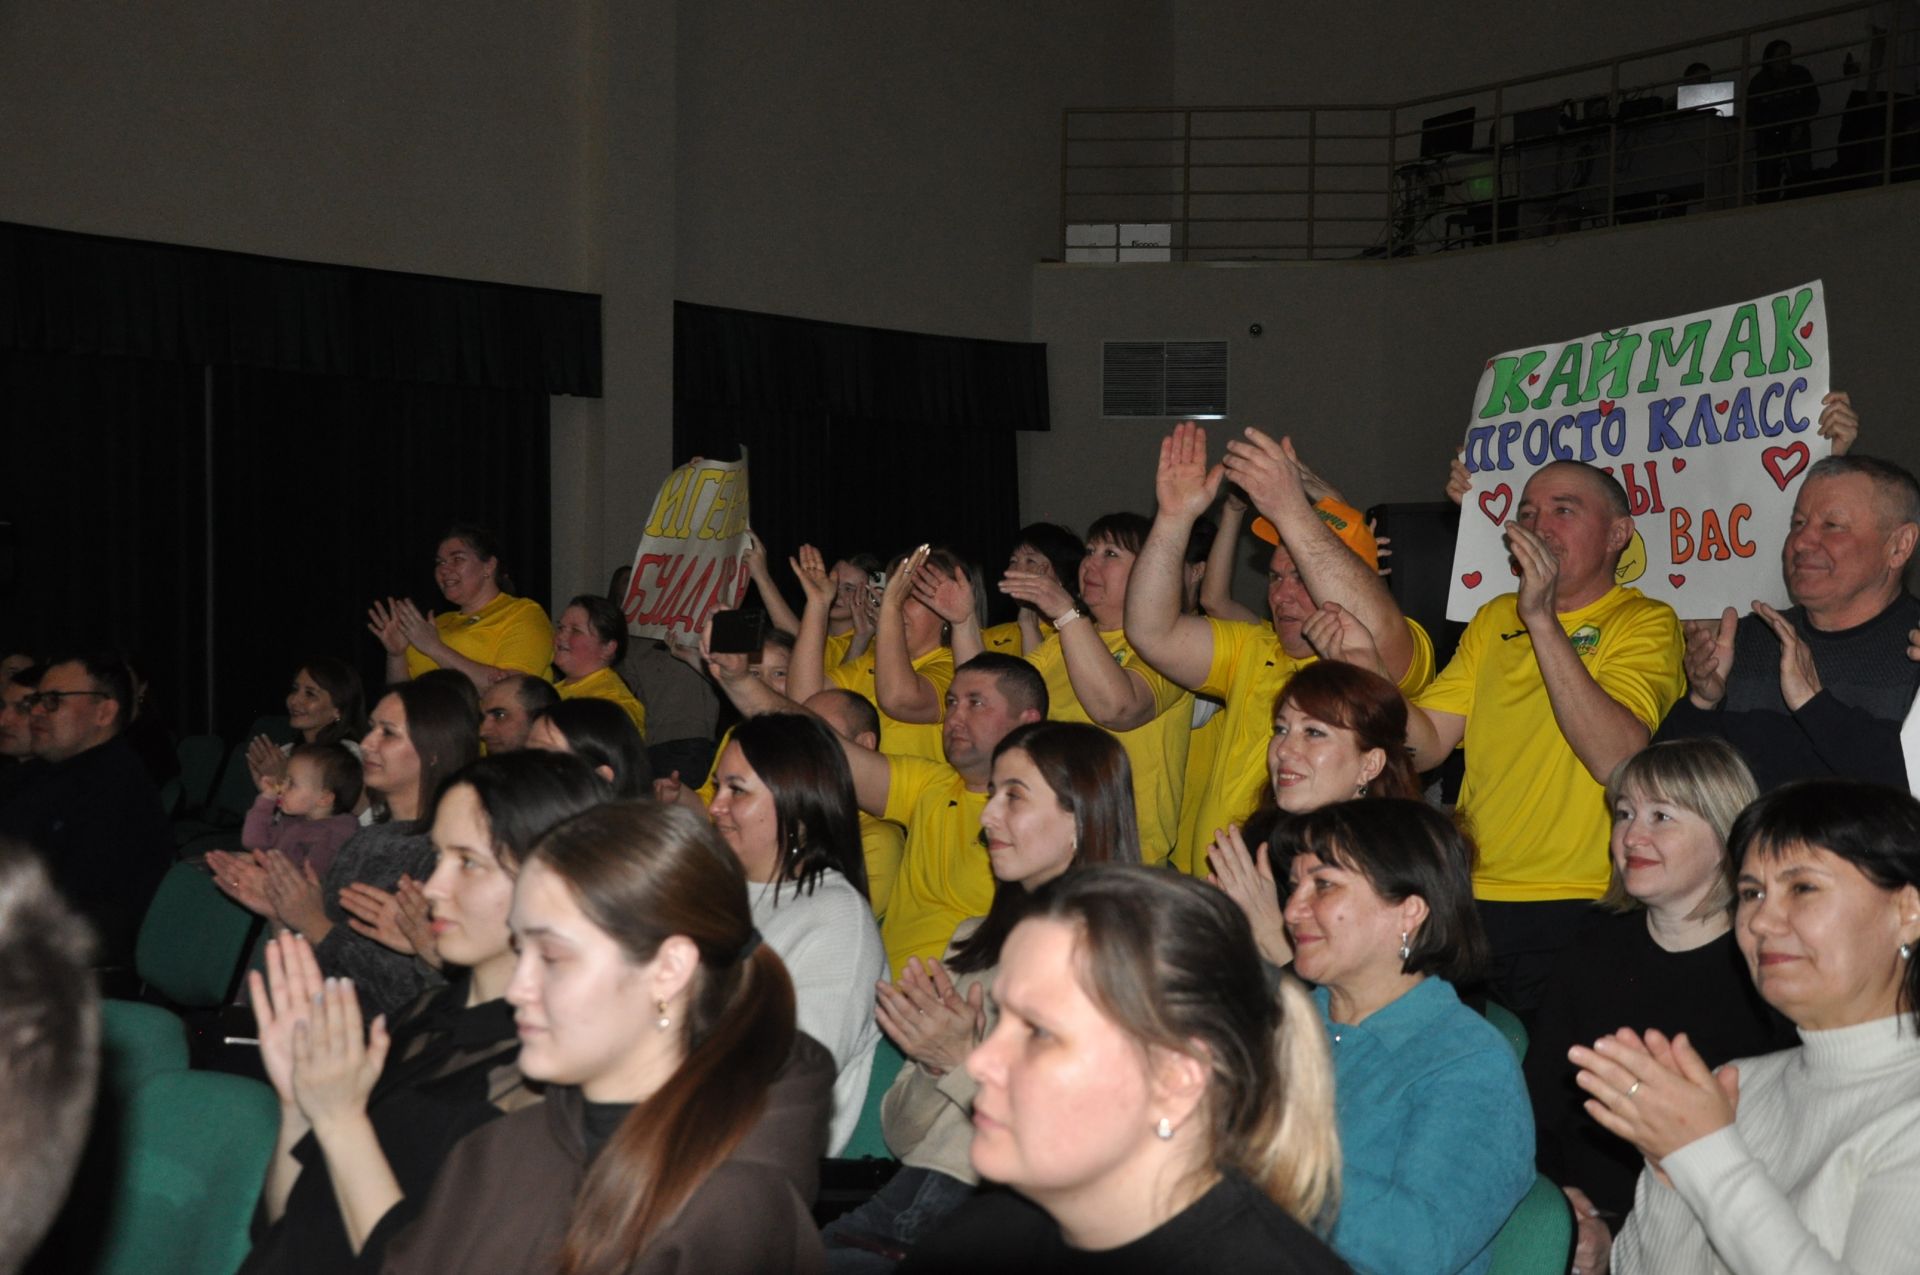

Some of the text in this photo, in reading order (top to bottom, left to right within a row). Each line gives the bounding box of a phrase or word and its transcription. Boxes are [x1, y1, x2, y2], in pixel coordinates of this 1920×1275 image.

[1478, 287, 1814, 419] КАЙМАК
[1465, 376, 1811, 473] ПРОСТО КЛАСС
[1601, 460, 1666, 516] Ы
[1669, 503, 1757, 564] ВАС
